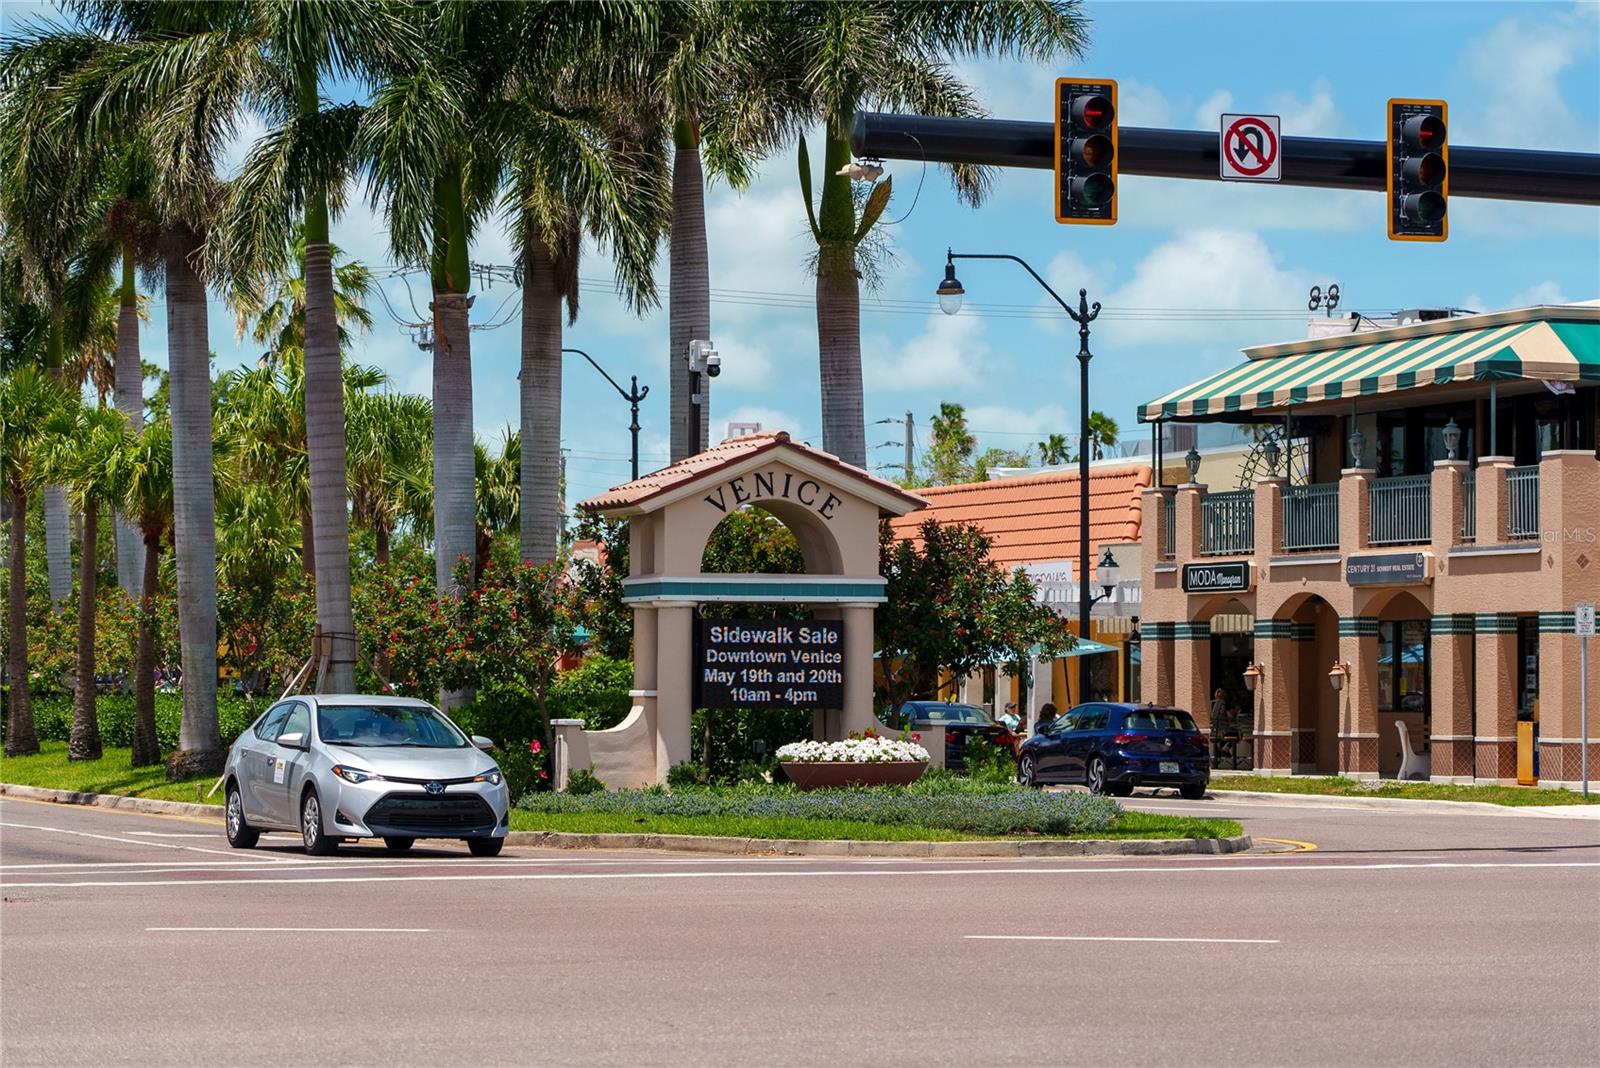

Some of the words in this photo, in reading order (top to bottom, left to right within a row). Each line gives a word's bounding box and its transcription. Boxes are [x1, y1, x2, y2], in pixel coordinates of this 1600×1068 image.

[704, 471, 842, 520] VENICE
[1348, 564, 1369, 574] CENTURY
[1392, 564, 1402, 572] REAL
[1402, 564, 1415, 572] ESTATE
[1190, 570, 1216, 586] MODA
[710, 626, 794, 645] Sidewalk
[798, 626, 838, 645] Sale
[706, 649, 787, 664] Downtown
[791, 649, 842, 664] Venice
[704, 669, 736, 687] May
[741, 668, 773, 684] 19th
[777, 669, 805, 684] and
[809, 668, 842, 684] 20th
[730, 688, 771, 703] 10am
[784, 688, 818, 705] 4pm
